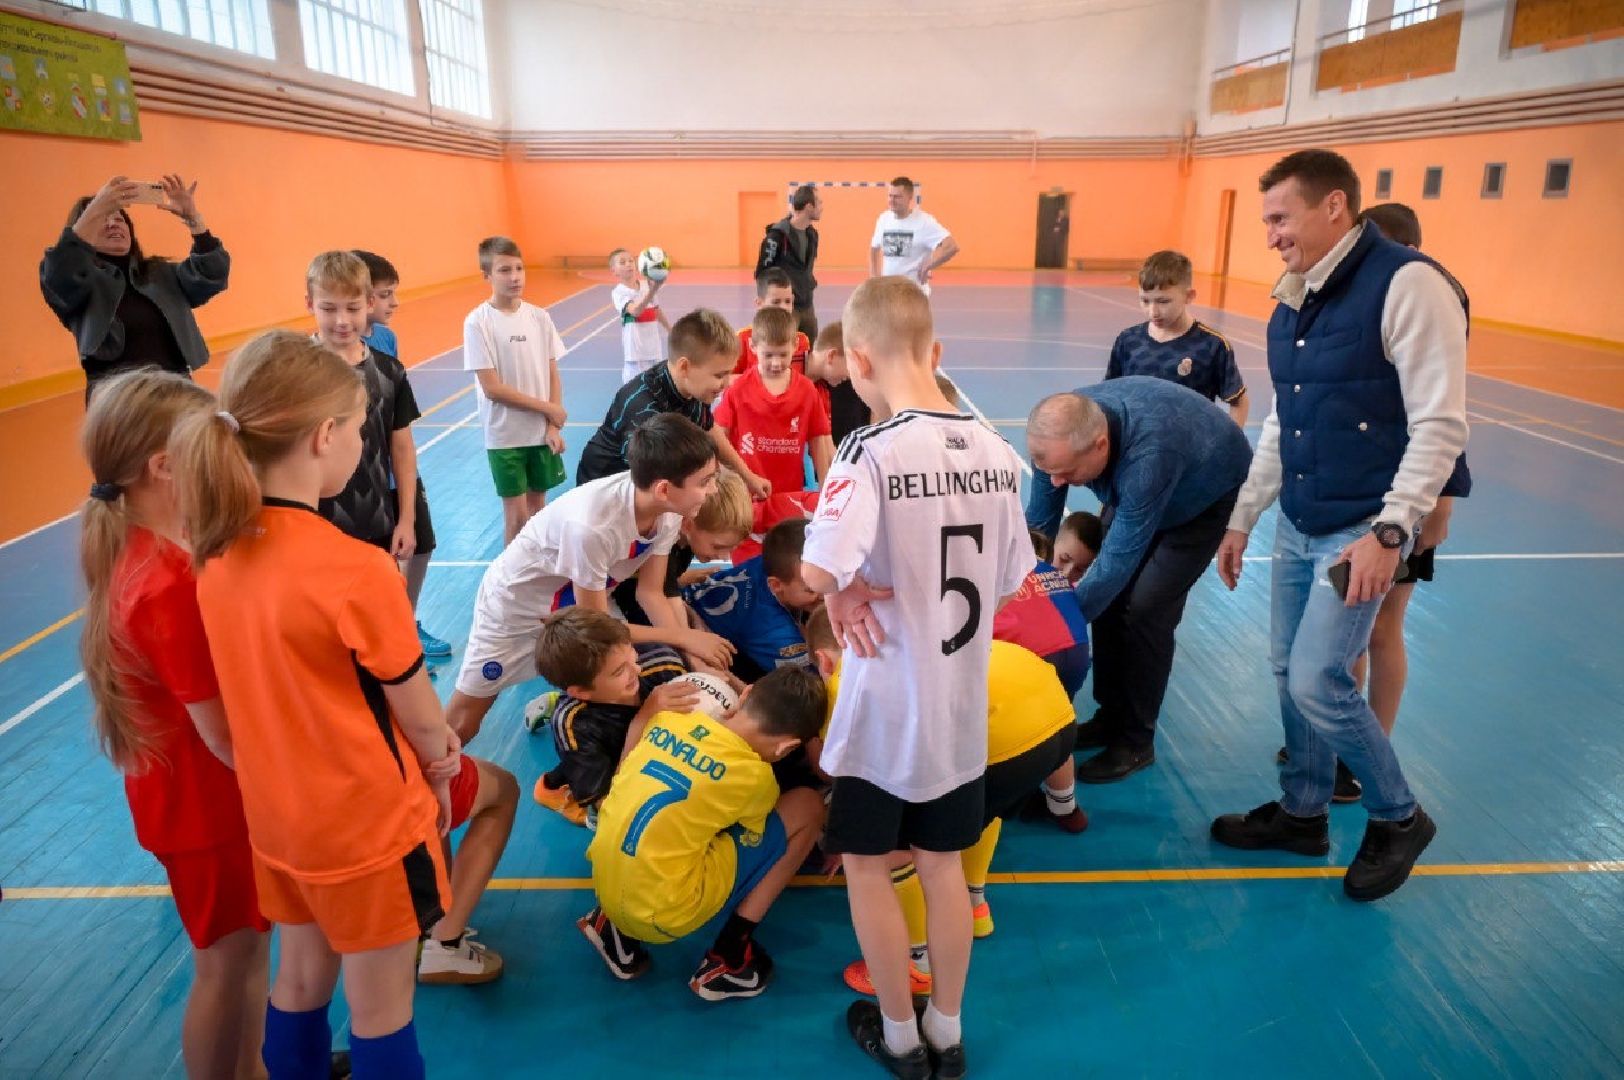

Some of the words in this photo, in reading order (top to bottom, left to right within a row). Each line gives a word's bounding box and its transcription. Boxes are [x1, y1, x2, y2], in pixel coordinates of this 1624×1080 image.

[887, 468, 1018, 501] BELLINGHAM
[940, 523, 984, 657] 5
[647, 726, 727, 781] RONALDO
[620, 759, 693, 857] 7
